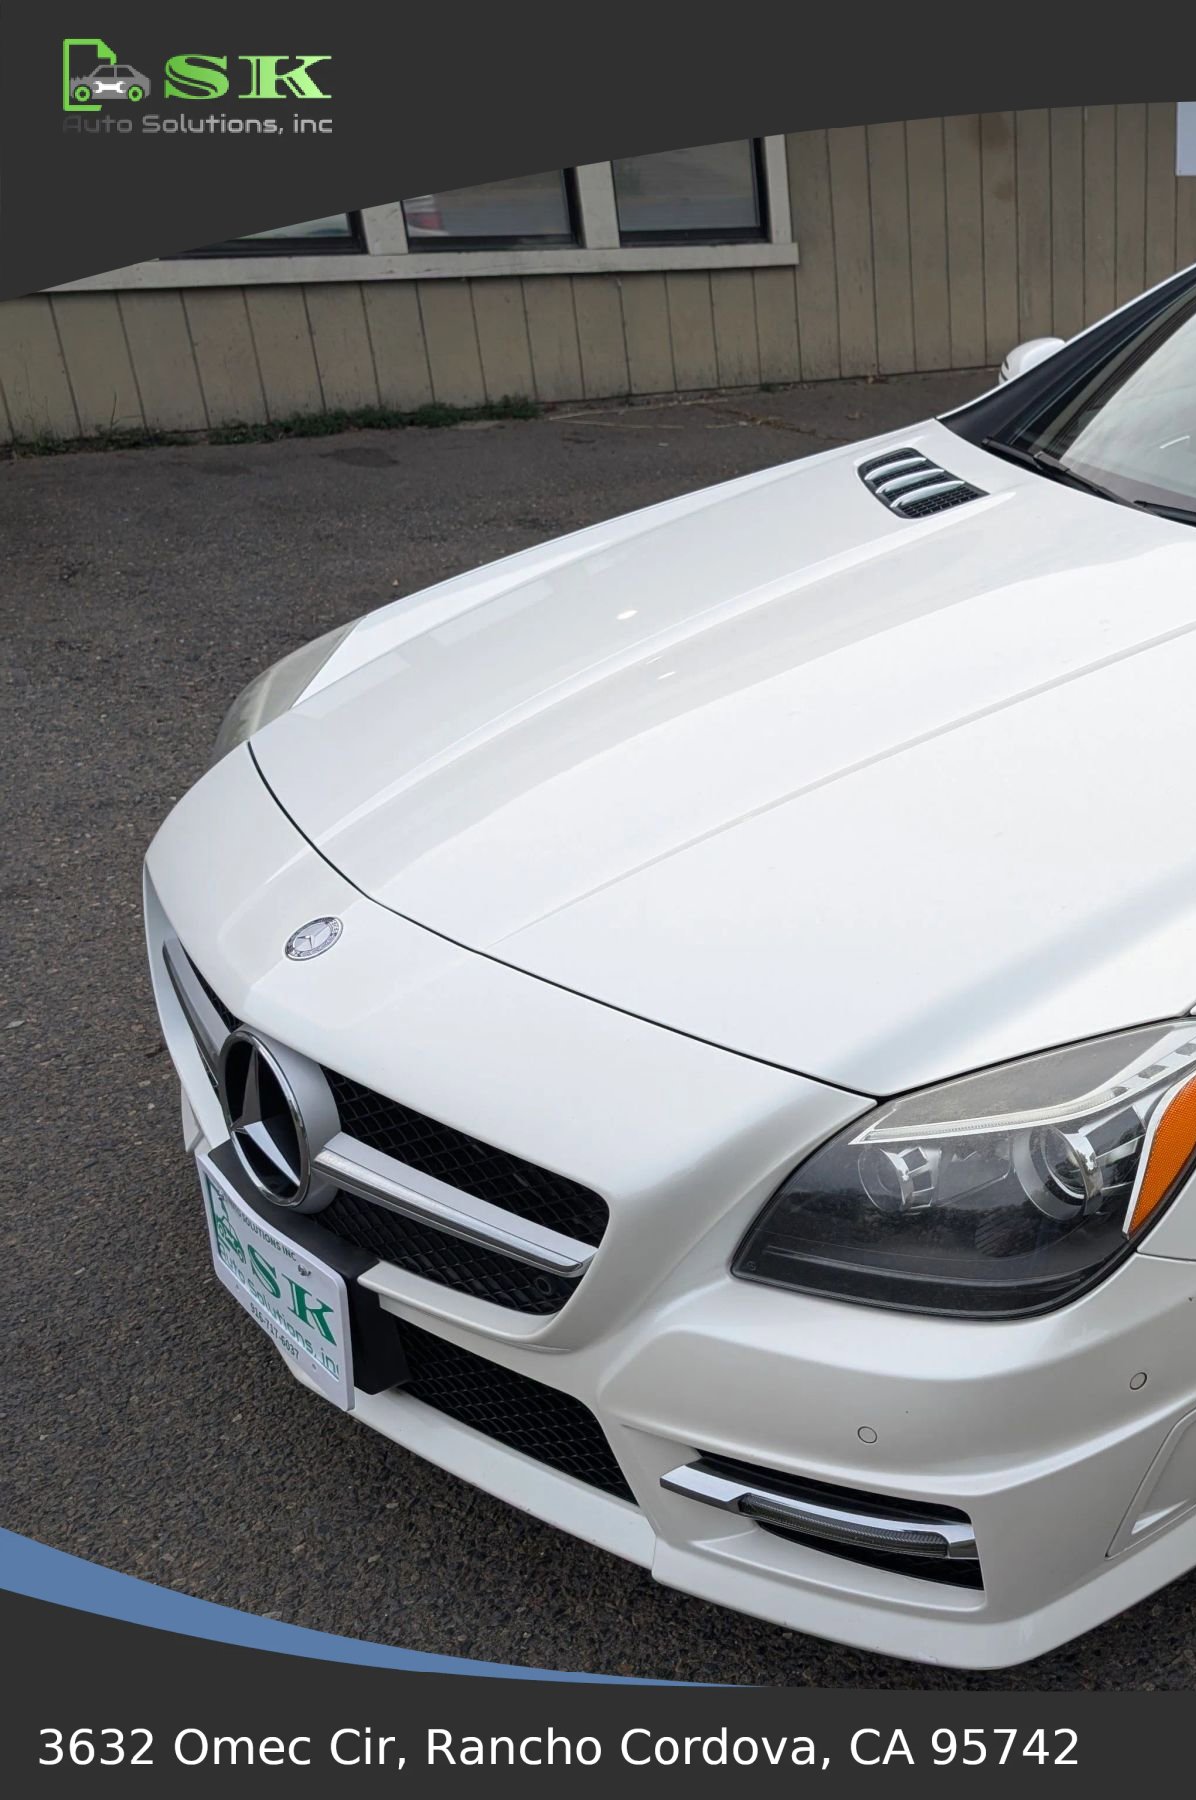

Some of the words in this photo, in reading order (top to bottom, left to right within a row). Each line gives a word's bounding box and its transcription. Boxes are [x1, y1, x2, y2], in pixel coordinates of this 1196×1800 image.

[282, 1245, 297, 1262] INC
[247, 1243, 338, 1347] SK
[250, 1301, 300, 1360] 916-717-6037
